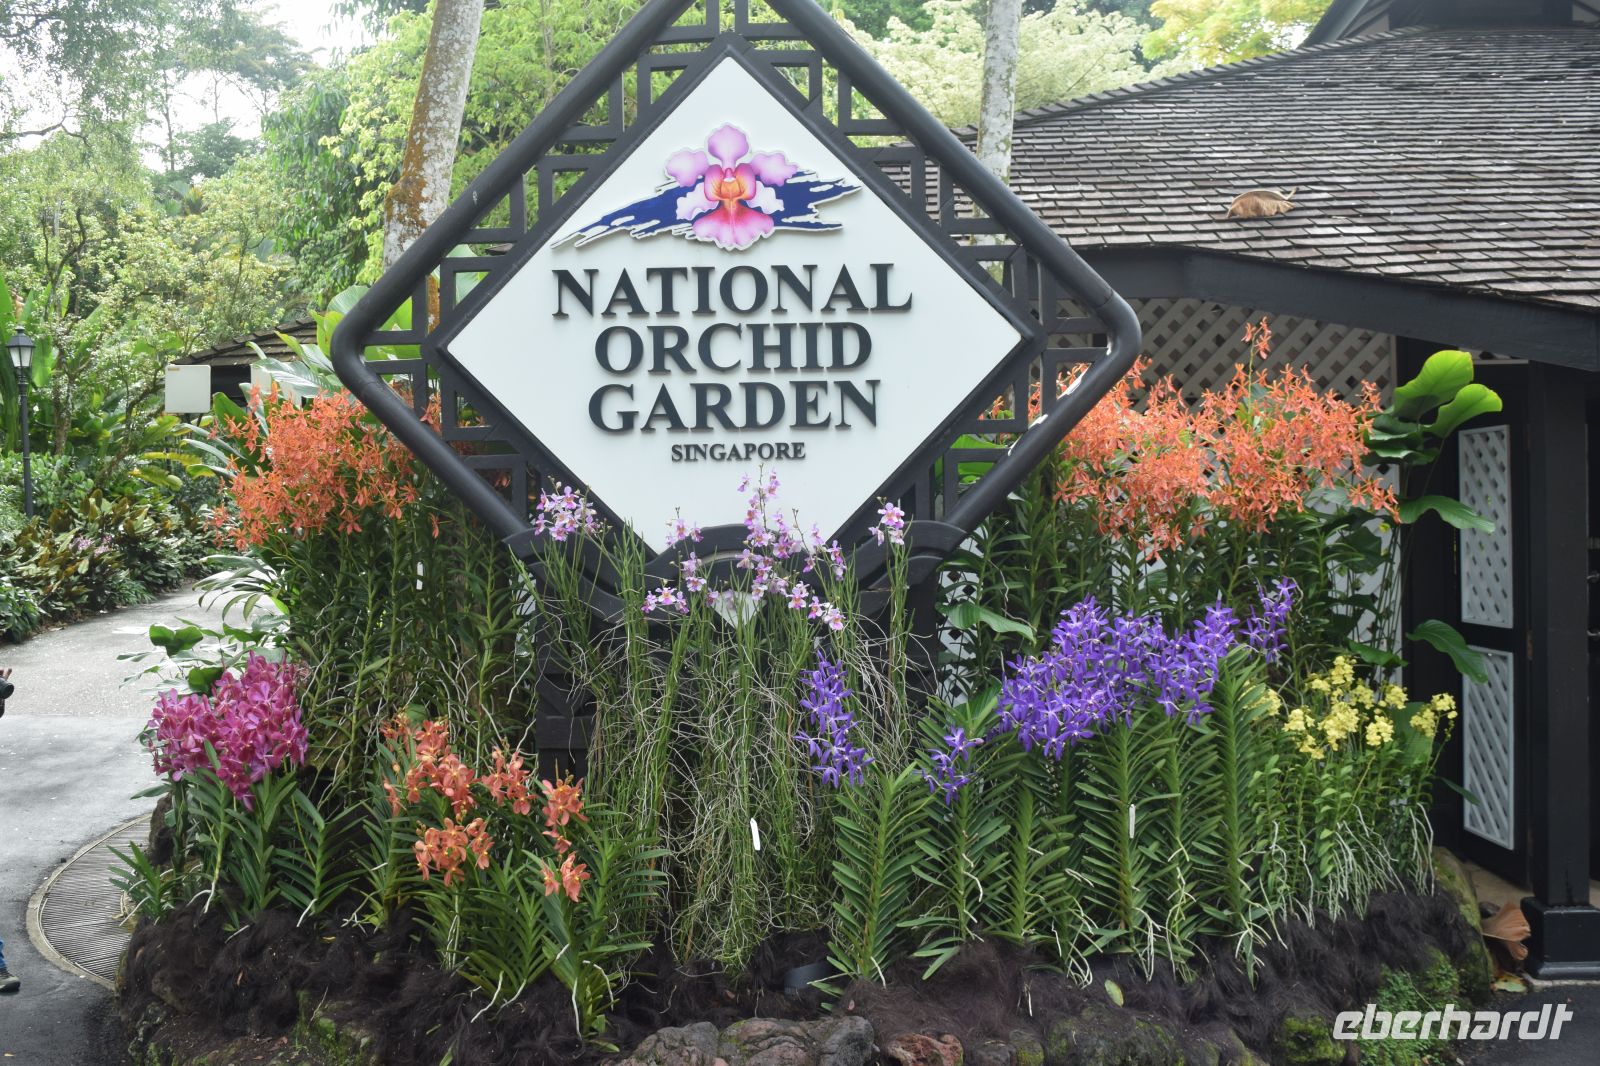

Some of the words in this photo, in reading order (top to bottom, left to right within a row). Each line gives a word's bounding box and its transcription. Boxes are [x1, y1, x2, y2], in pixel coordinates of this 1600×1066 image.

[552, 264, 912, 319] NATIONAL
[595, 322, 872, 376] ORCHID
[589, 380, 881, 435] GARDEN
[671, 443, 806, 463] SINGAPORE
